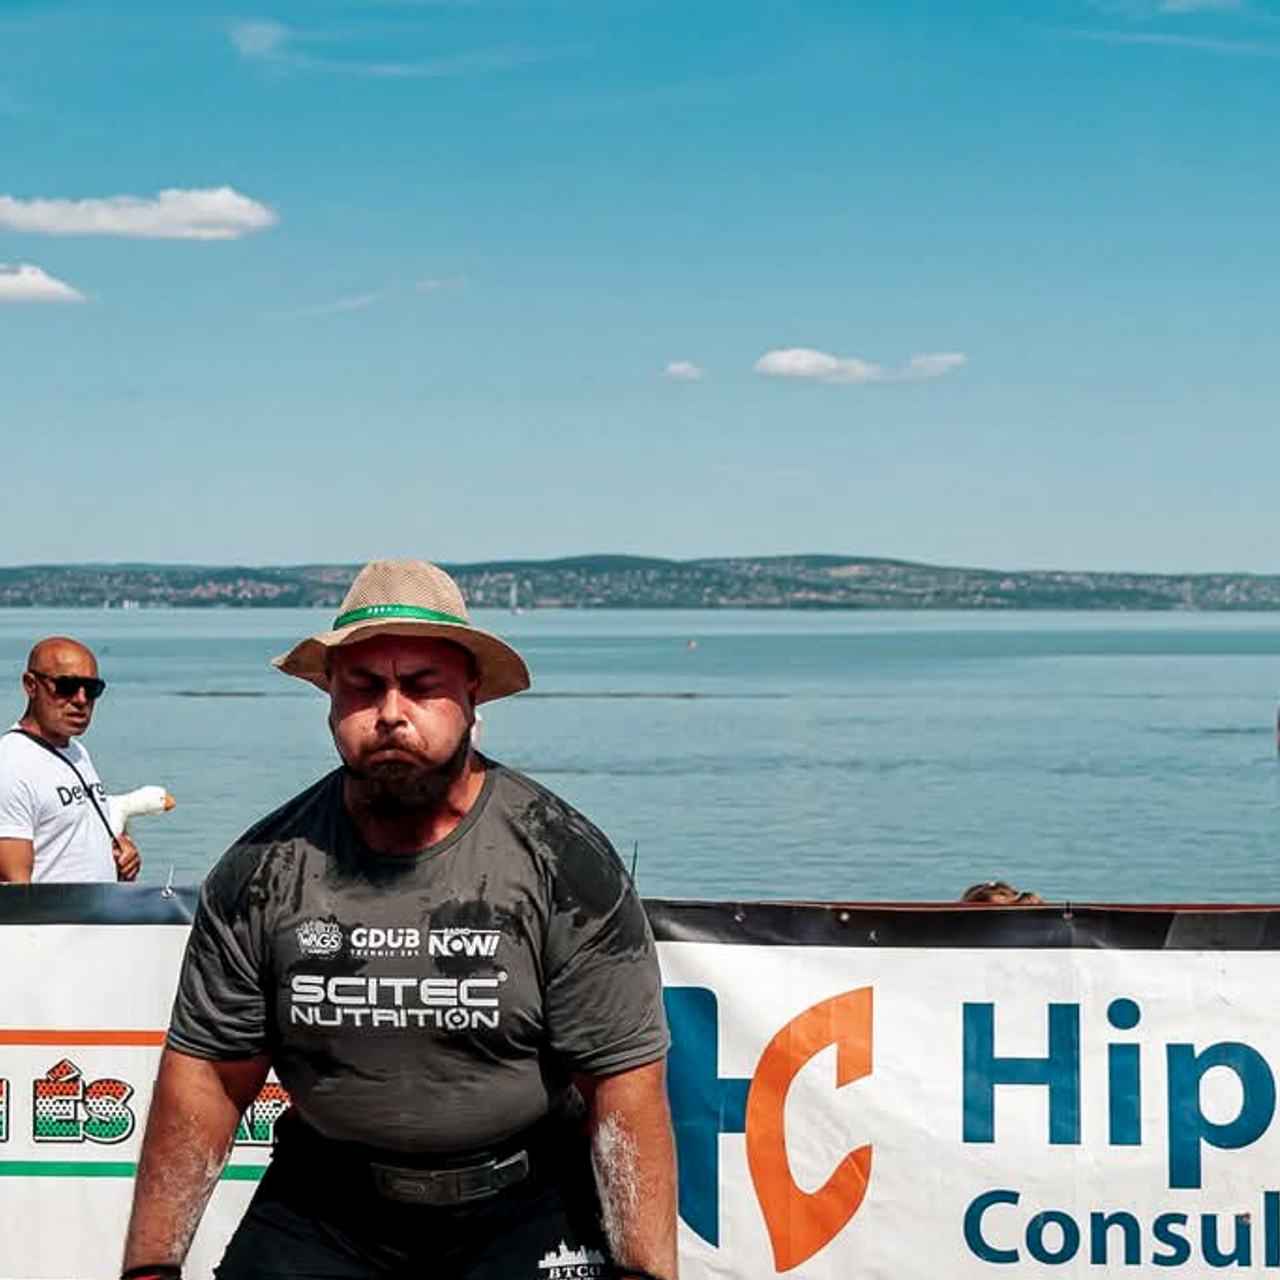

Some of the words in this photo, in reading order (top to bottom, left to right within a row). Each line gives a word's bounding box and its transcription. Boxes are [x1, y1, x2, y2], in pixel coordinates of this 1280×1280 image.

[351, 927, 420, 948] GDUB
[291, 1004, 500, 1030] NUTRITION
[32, 1058, 137, 1144] ÉS
